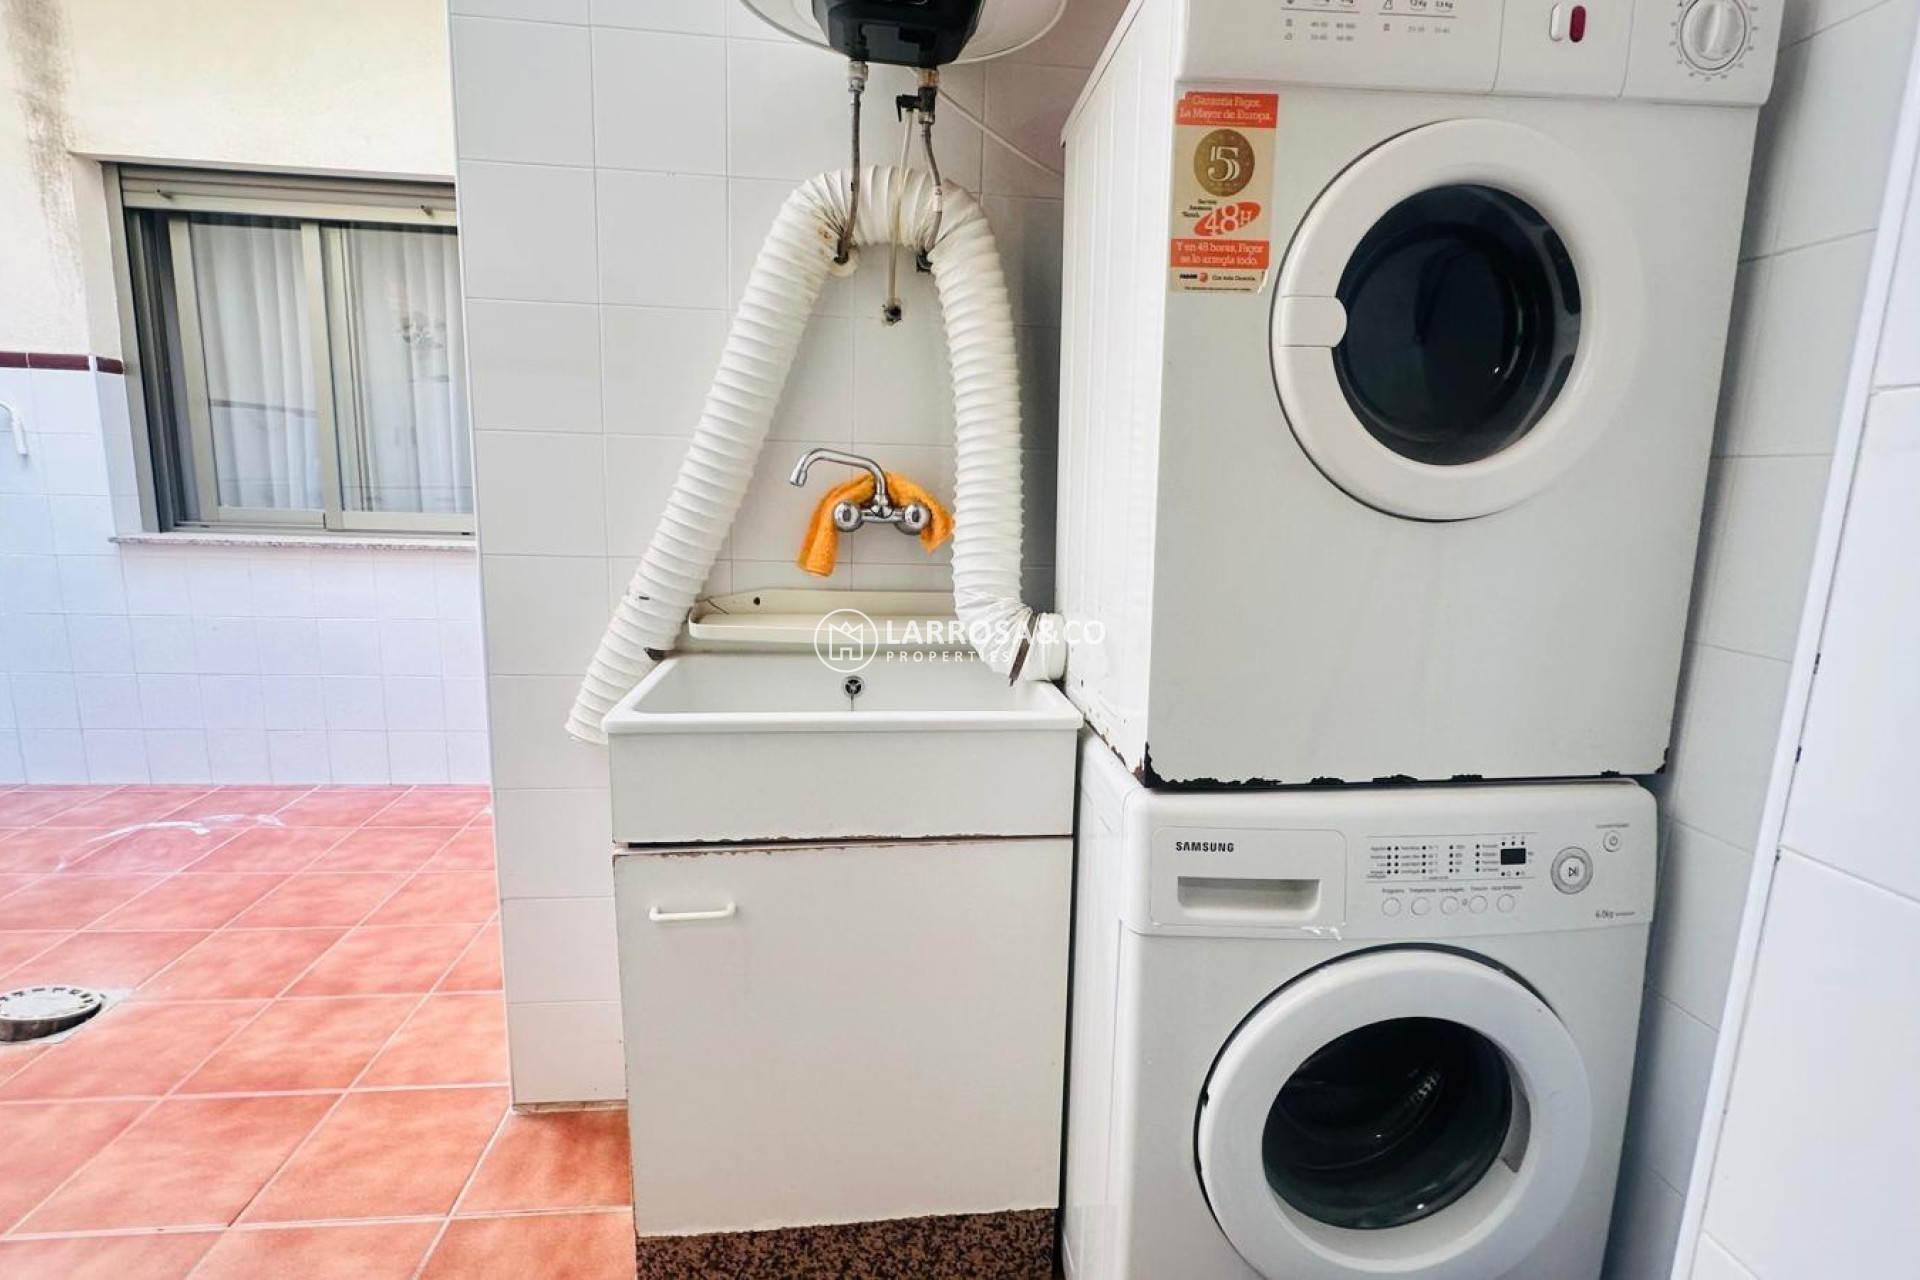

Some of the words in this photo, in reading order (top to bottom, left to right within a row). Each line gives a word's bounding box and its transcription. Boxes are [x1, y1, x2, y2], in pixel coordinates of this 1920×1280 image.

[1193, 108, 1222, 121] Mayor
[1223, 109, 1236, 119] de
[1176, 241, 1182, 251] Y
[1184, 243, 1196, 251] en
[1198, 241, 1209, 251] 48
[1191, 253, 1201, 263] lo
[1175, 841, 1235, 853] SAMSUNG
